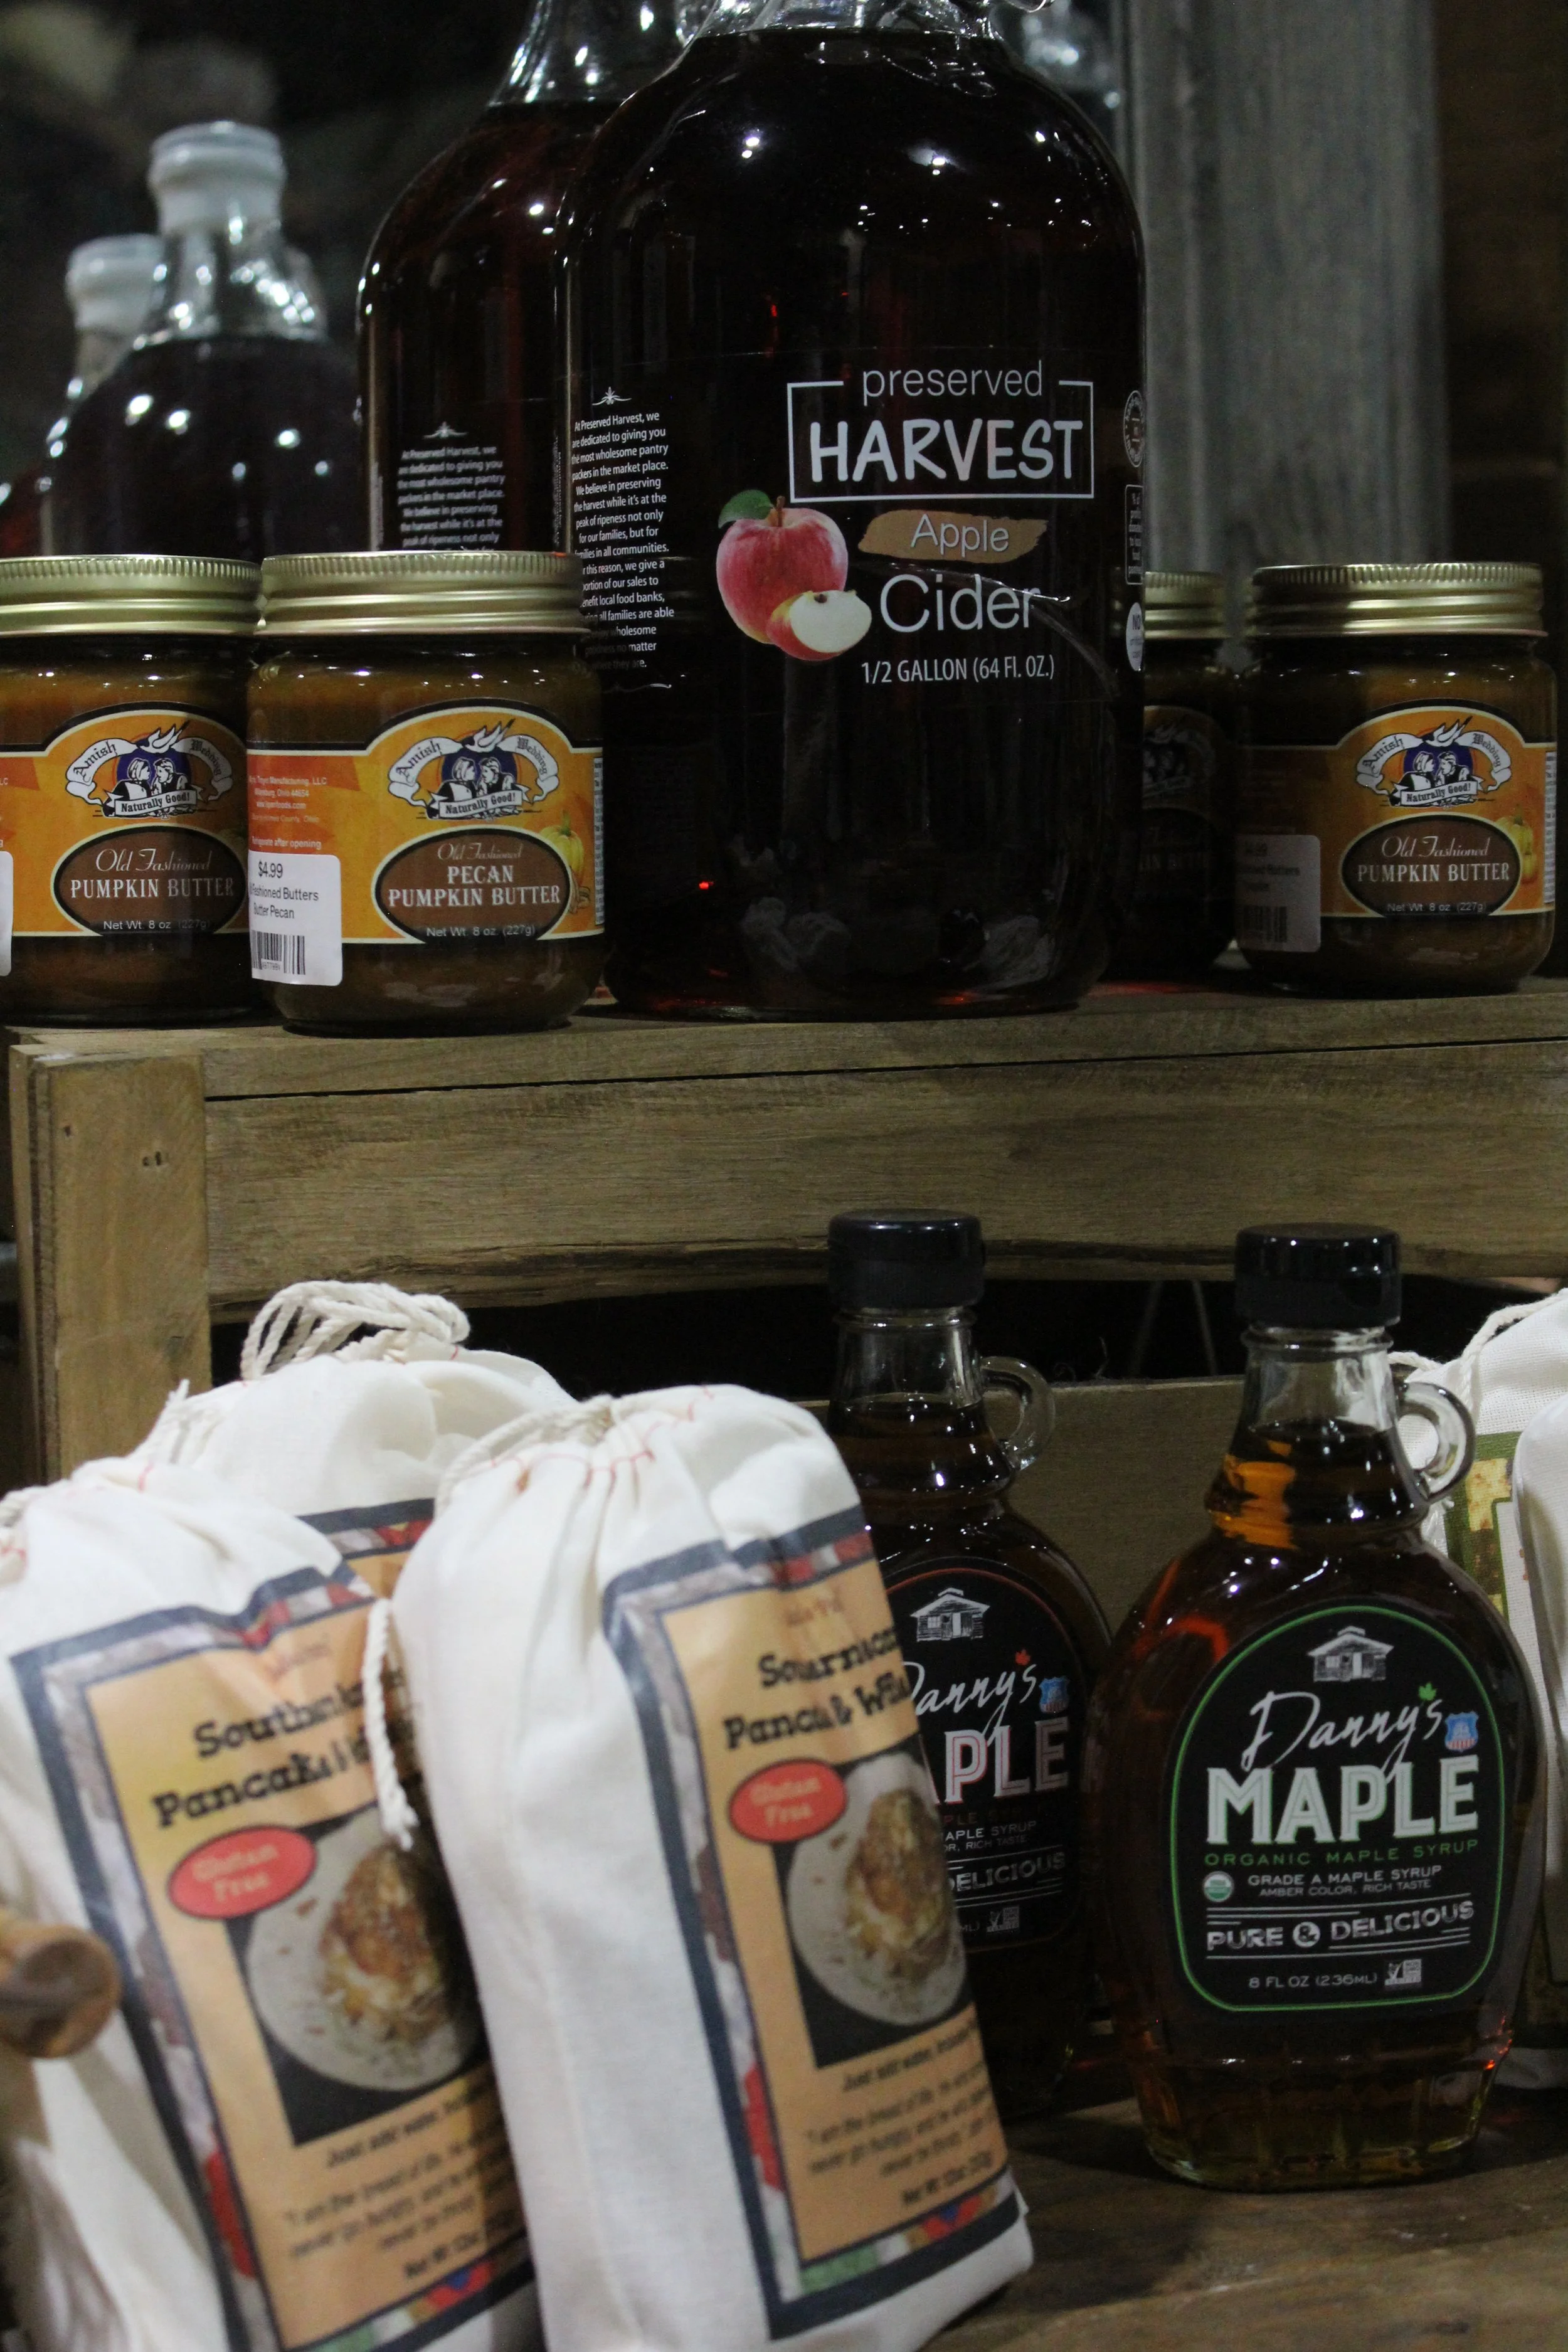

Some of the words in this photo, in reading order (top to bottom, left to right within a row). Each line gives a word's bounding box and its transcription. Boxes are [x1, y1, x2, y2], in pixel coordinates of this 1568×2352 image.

[863, 360, 1042, 405] preserved
[575, 421, 581, 432] At
[581, 415, 611, 431] Preserved
[612, 412, 644, 425] Harvest,
[646, 412, 660, 422] we
[572, 440, 580, 448] are
[581, 432, 610, 447] dedicated
[612, 433, 620, 442] to
[621, 429, 647, 443] giving
[649, 428, 666, 440] you
[571, 454, 580, 465] the
[581, 452, 595, 463] most
[596, 448, 637, 460] wholesome
[638, 444, 669, 458] pantry
[810, 418, 1083, 482] HARVEST
[572, 469, 592, 483] packers
[593, 467, 599, 477] in
[600, 465, 612, 476] the
[613, 462, 640, 475] market
[642, 460, 669, 474] place.
[576, 486, 585, 496] We
[585, 482, 608, 495] believe
[608, 481, 615, 492] in
[617, 477, 661, 493] preserving
[574, 502, 583, 512] the
[583, 499, 606, 511] harvest
[607, 495, 626, 507] while
[628, 494, 639, 506] it's
[640, 494, 650, 504] at
[651, 492, 667, 502] the
[576, 516, 590, 531] peak
[590, 515, 596, 526] of
[597, 514, 626, 527] ripeness
[628, 512, 642, 522] not
[644, 509, 664, 522] only
[579, 533, 587, 544] for
[588, 534, 598, 543] our
[599, 528, 628, 541] families,
[629, 527, 644, 538] but
[645, 525, 659, 537] for
[911, 514, 1009, 557] Apple
[596, 547, 602, 557] in
[603, 546, 612, 557] all
[612, 542, 669, 556] communities.
[586, 564, 597, 575] this
[598, 563, 624, 573] reason,
[625, 562, 637, 571] we
[638, 559, 657, 573] give
[659, 560, 665, 568] a
[604, 578, 612, 588] of
[612, 578, 626, 588] our
[627, 576, 647, 587] sales
[649, 576, 659, 586] to
[580, 596, 598, 608] enefit
[600, 594, 615, 606] local
[617, 592, 635, 604] food
[636, 590, 665, 603] banks,
[880, 574, 1040, 633] Cider
[599, 610, 607, 622] all
[608, 609, 637, 621] families
[638, 610, 652, 618] are
[654, 606, 675, 618] able
[628, 642, 657, 652] matter
[861, 661, 892, 684] 1/2
[898, 658, 967, 682] GALLON
[973, 657, 1000, 683] (64
[1025, 654, 1055, 680] OZ.)
[73, 741, 117, 783] Amish
[191, 739, 222, 776] Wedding
[395, 739, 442, 782] Amish
[517, 736, 548, 775] Wedding
[1362, 736, 1404, 775] Amish
[1471, 733, 1502, 768] Wedding
[312, 777, 327, 785] LLC
[121, 798, 162, 812] Naturally
[165, 791, 190, 805] Good!
[1406, 788, 1446, 802] Naturally
[1448, 781, 1471, 795] Good!
[445, 797, 488, 815] Naturally
[491, 792, 516, 805] Good!
[290, 839, 322, 850] opening
[437, 842, 464, 861] Old
[467, 842, 524, 860] Fashioned
[1381, 835, 1417, 858] Old
[1418, 835, 1491, 857] Fashioned
[95, 848, 134, 872] Old
[135, 848, 213, 871] Fashioned
[258, 861, 283, 879] $4.99
[447, 865, 514, 884] PECAN
[1357, 864, 1439, 882] PUMPKIN
[1448, 862, 1510, 881] BUTTER
[71, 879, 159, 898] PUMPKIN
[167, 877, 234, 897] BUTTER
[283, 887, 319, 901] Butters
[388, 888, 483, 908] PUMPKIN
[492, 885, 561, 906] BUTTER
[253, 903, 269, 916] Butter
[270, 904, 294, 919] Pecan
[1387, 903, 1406, 912] Net
[1429, 902, 1436, 911] 8
[1456, 902, 1486, 913] (227g)
[103, 921, 123, 930] Net
[149, 920, 156, 930] 8
[178, 919, 211, 931] (227g)
[426, 928, 446, 937] Net
[473, 926, 480, 936] 8
[503, 925, 535, 937] (227g)
[1241, 1690, 1443, 1785] Danny's
[919, 1717, 1069, 1806] PLE
[1206, 1755, 1479, 1845] MAPLE
[945, 1828, 985, 1841] APLE
[990, 1820, 1037, 1836] SYRUP
[966, 1839, 992, 1850] RICH
[997, 1835, 1028, 1846] TASTE
[1204, 1851, 1311, 1867] ORGANIC
[1325, 1847, 1400, 1863] MAPLE
[1412, 1839, 1478, 1858] SYRUP
[1248, 1874, 1305, 1887] GRADE
[1311, 1874, 1322, 1884] A
[1328, 1870, 1384, 1883] MAPLE
[1391, 1865, 1442, 1880] SYRUP
[1259, 1887, 1304, 1897] AMBER
[1308, 1885, 1357, 1896] COLOR,
[1362, 1881, 1392, 1893] RICH
[1396, 1878, 1432, 1890] TASTE
[1206, 1927, 1285, 1951] PURE
[1330, 1900, 1474, 1941] DELICIOUS
[1248, 1977, 1260, 1989] 8
[1265, 1976, 1285, 1988] FL
[1288, 1976, 1310, 1987] OZ
[1316, 1973, 1378, 1987] (236ML)
